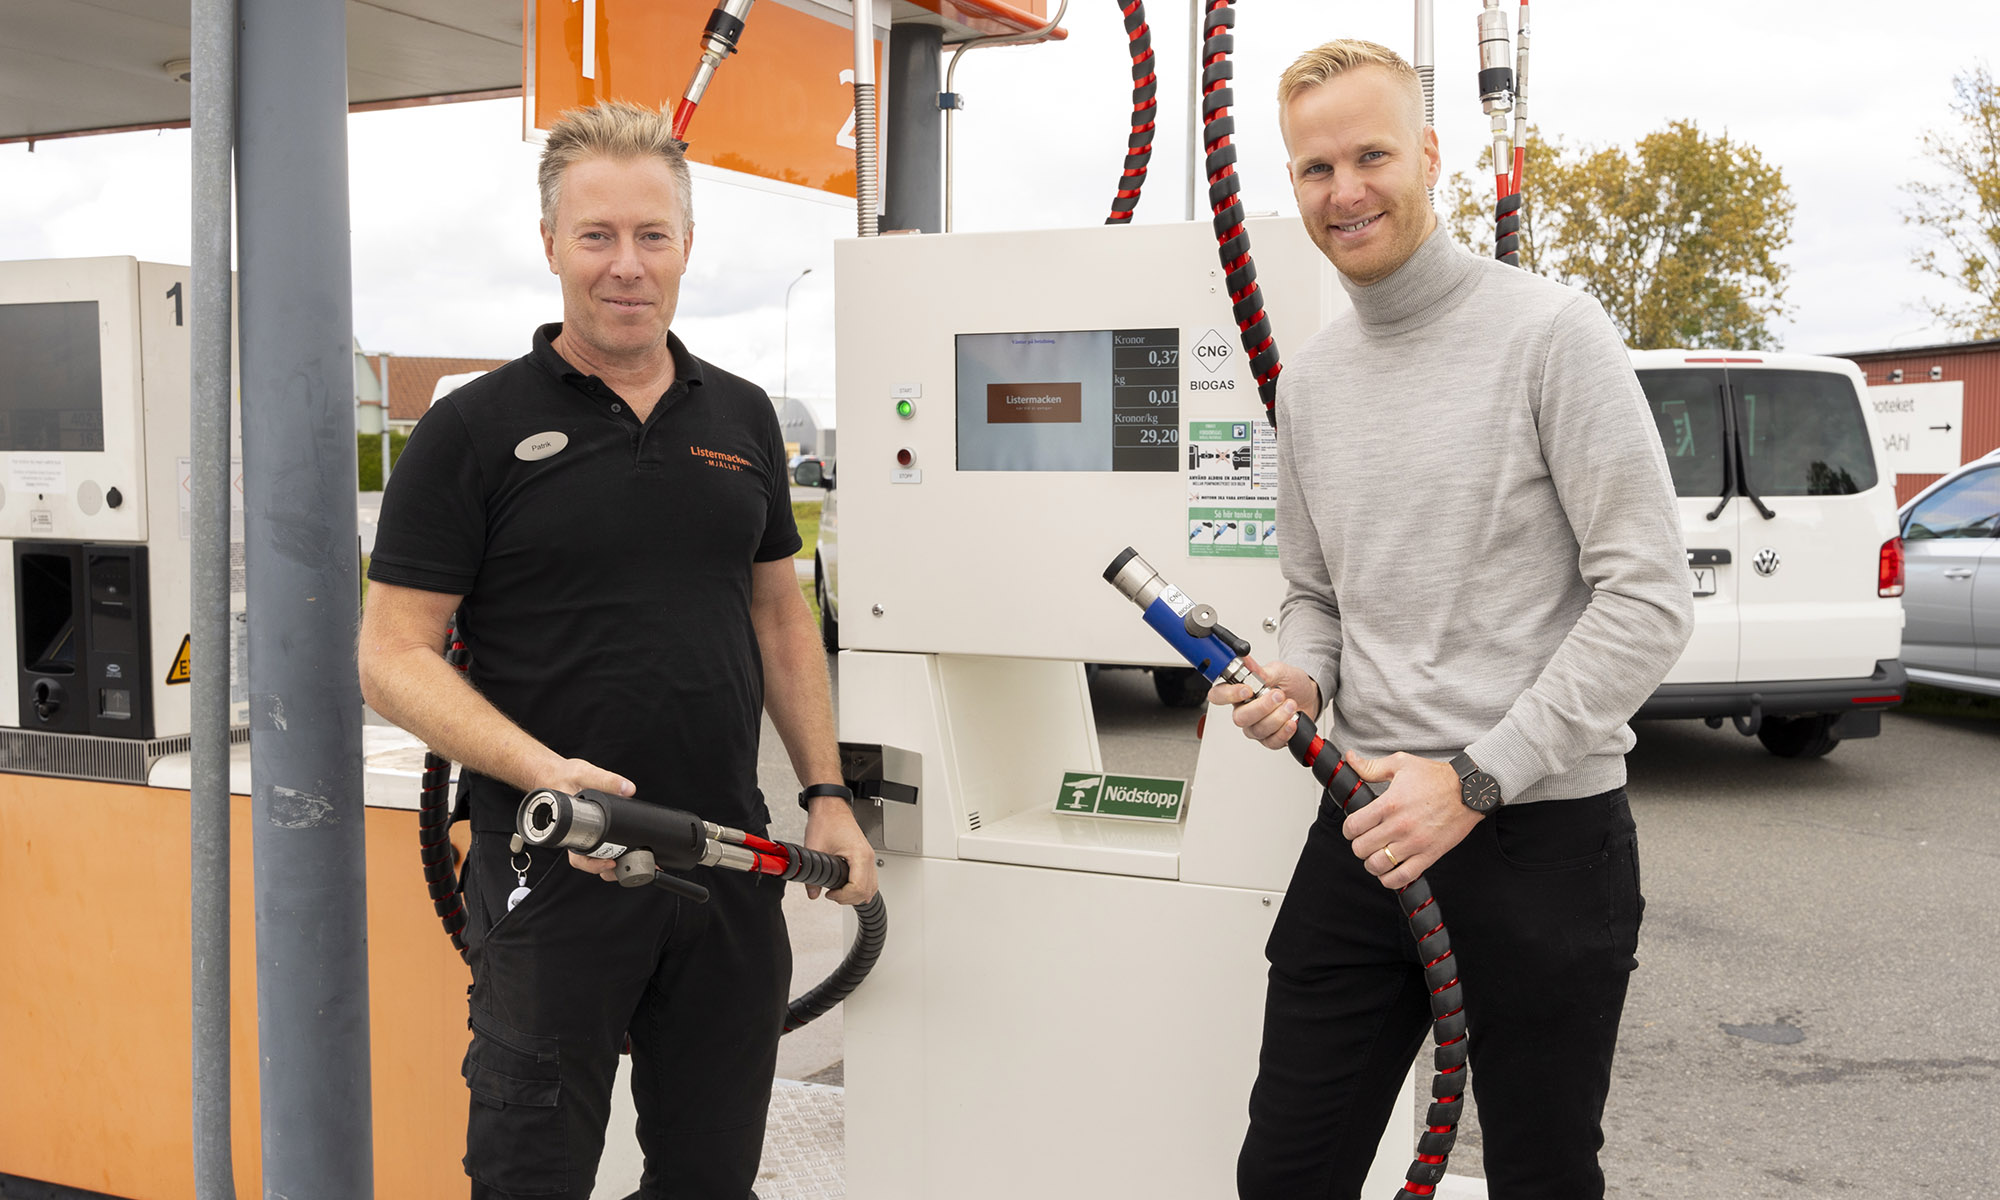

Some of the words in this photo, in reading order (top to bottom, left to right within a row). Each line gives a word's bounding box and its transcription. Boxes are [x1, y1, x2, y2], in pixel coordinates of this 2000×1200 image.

[166, 281, 183, 326] 1
[1114, 335, 1145, 345] Kronor
[1197, 345, 1228, 357] CNG
[1148, 350, 1179, 367] 0,37
[1114, 375, 1126, 386] kg
[1190, 380, 1235, 391] BIOGAS
[1006, 395, 1062, 405] Listermacken
[1148, 389, 1178, 406] 0,01
[1114, 413, 1159, 425] Kronor/kg
[1140, 429, 1179, 445] 29,20
[531, 441, 552, 451] Patrik
[1214, 509, 1222, 519] Så
[1223, 509, 1233, 519] här
[1234, 509, 1253, 519] tankar
[1254, 510, 1263, 519] du
[1169, 591, 1182, 602] CNG
[180, 659, 191, 675] E
[1104, 785, 1178, 809] Nödstopp
